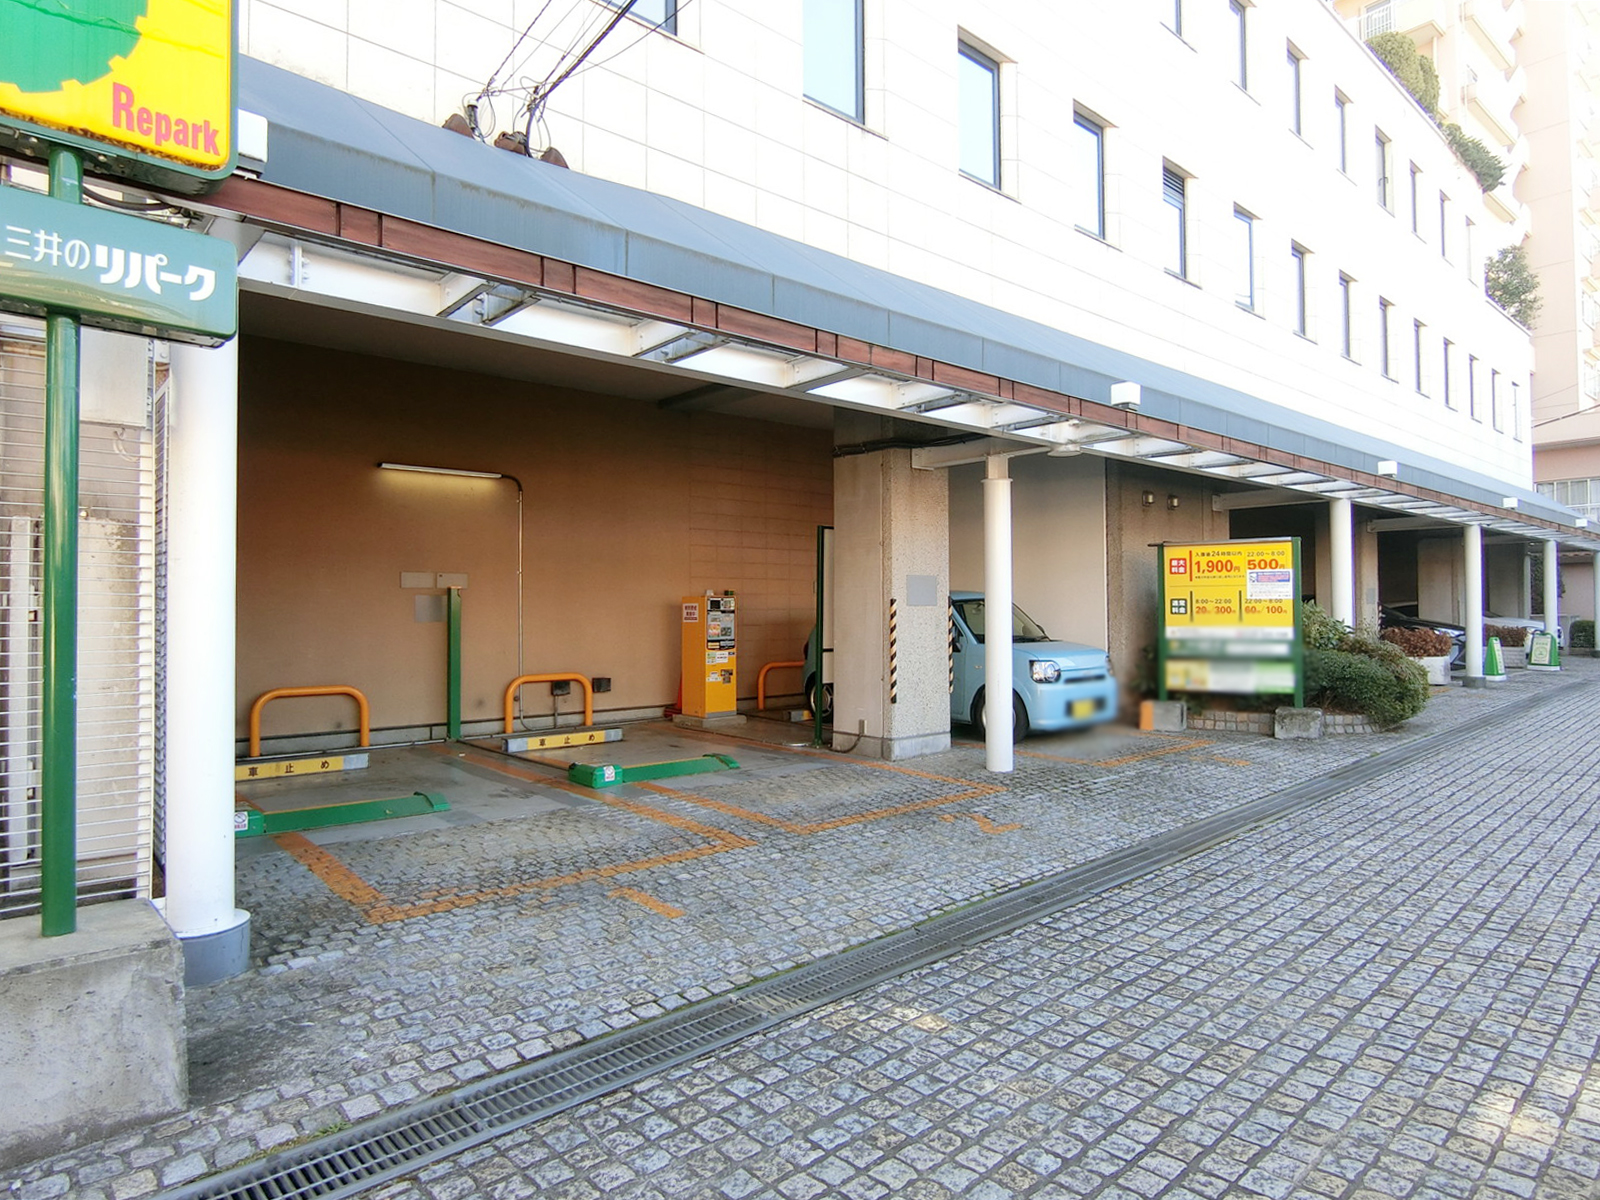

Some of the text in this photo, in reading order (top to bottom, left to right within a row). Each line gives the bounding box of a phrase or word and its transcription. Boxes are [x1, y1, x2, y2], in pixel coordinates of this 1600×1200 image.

[112, 82, 220, 156] Repark
[5, 224, 217, 302] 三井のリパーク
[1194, 559, 1241, 574] 1,900円
[539, 734, 596, 747] 車止め
[247, 760, 330, 777] 車止め
